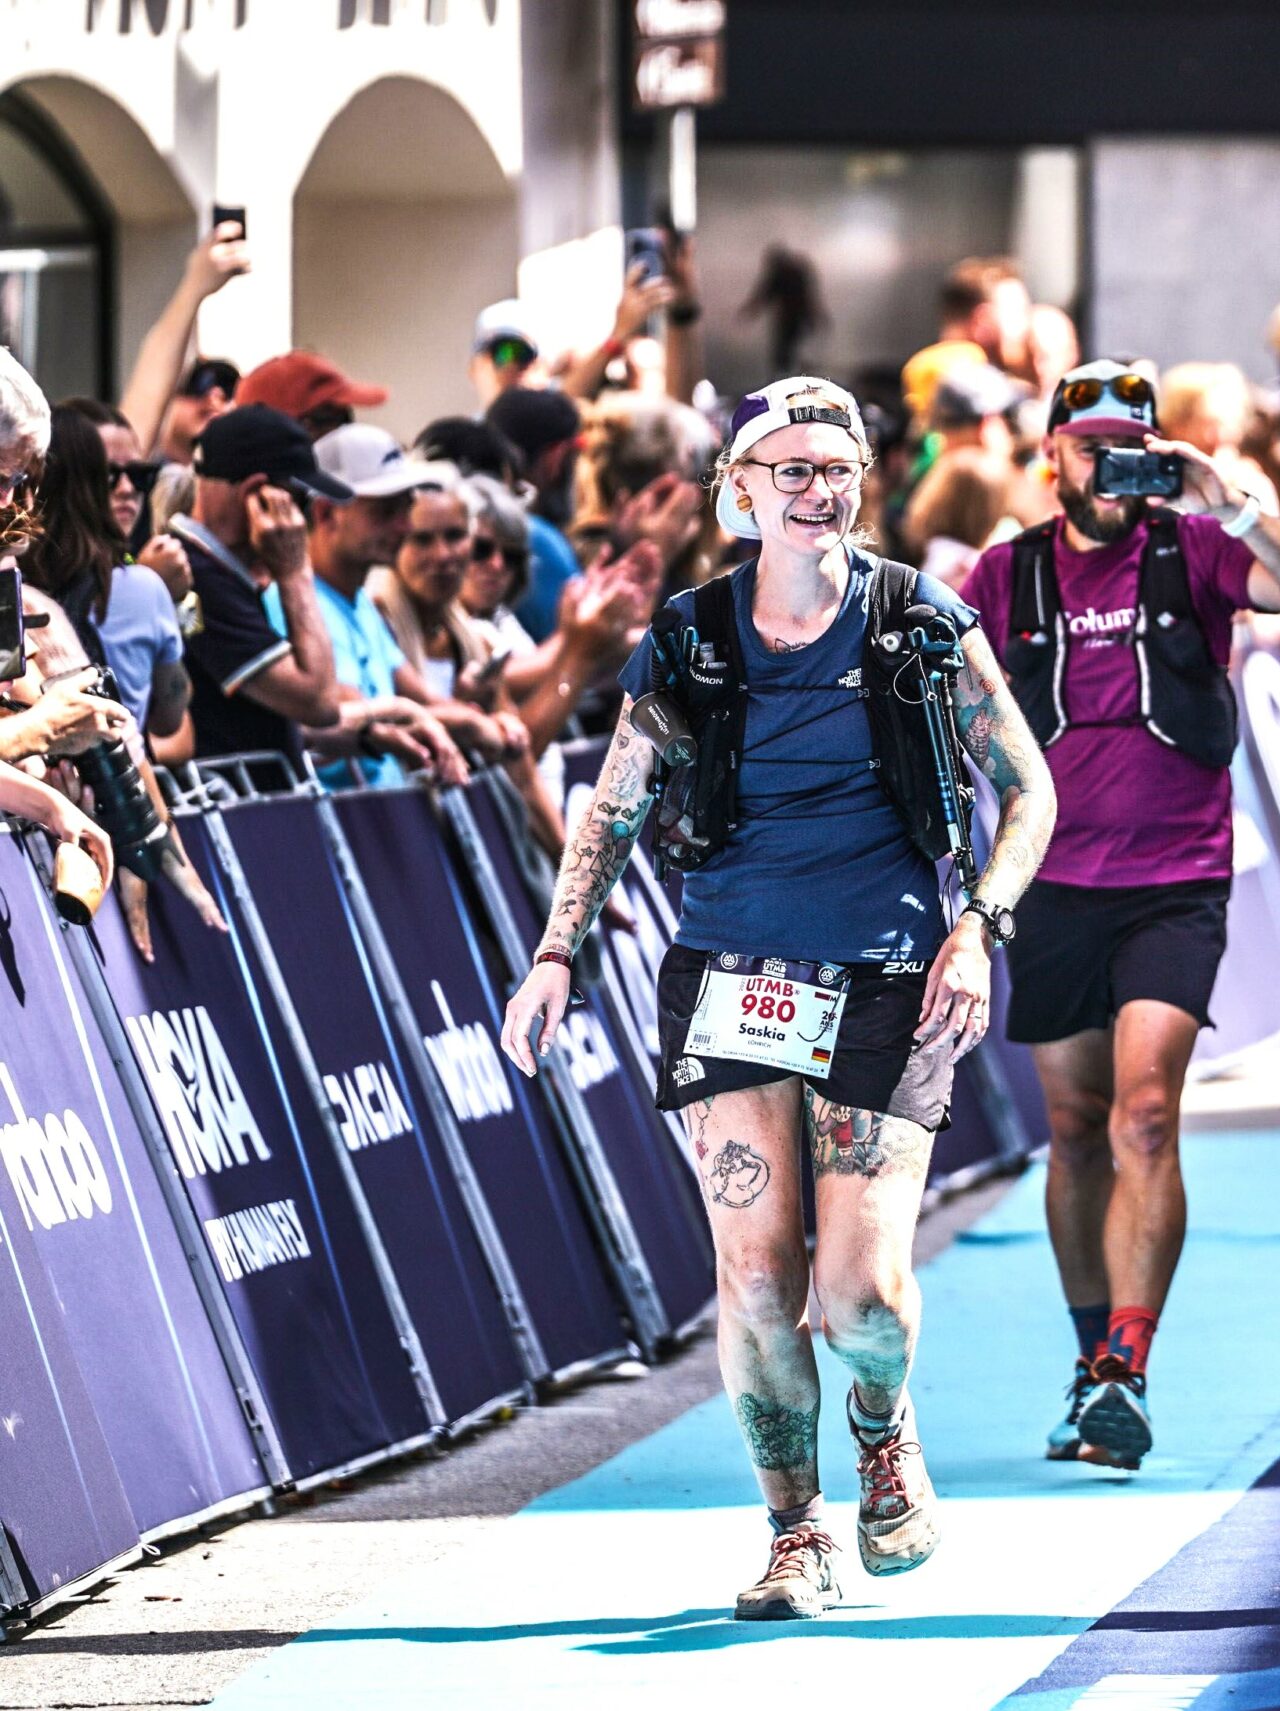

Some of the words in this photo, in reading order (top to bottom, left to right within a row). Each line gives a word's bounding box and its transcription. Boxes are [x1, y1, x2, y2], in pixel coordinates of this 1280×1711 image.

[1064, 607, 1136, 635] olum
[882, 960, 925, 974] 2XU
[741, 994, 796, 1023] 980
[738, 1022, 786, 1041] Saskia
[676, 1057, 688, 1070] THE
[126, 1005, 272, 1179] HOKA
[323, 1060, 413, 1150] DACIA
